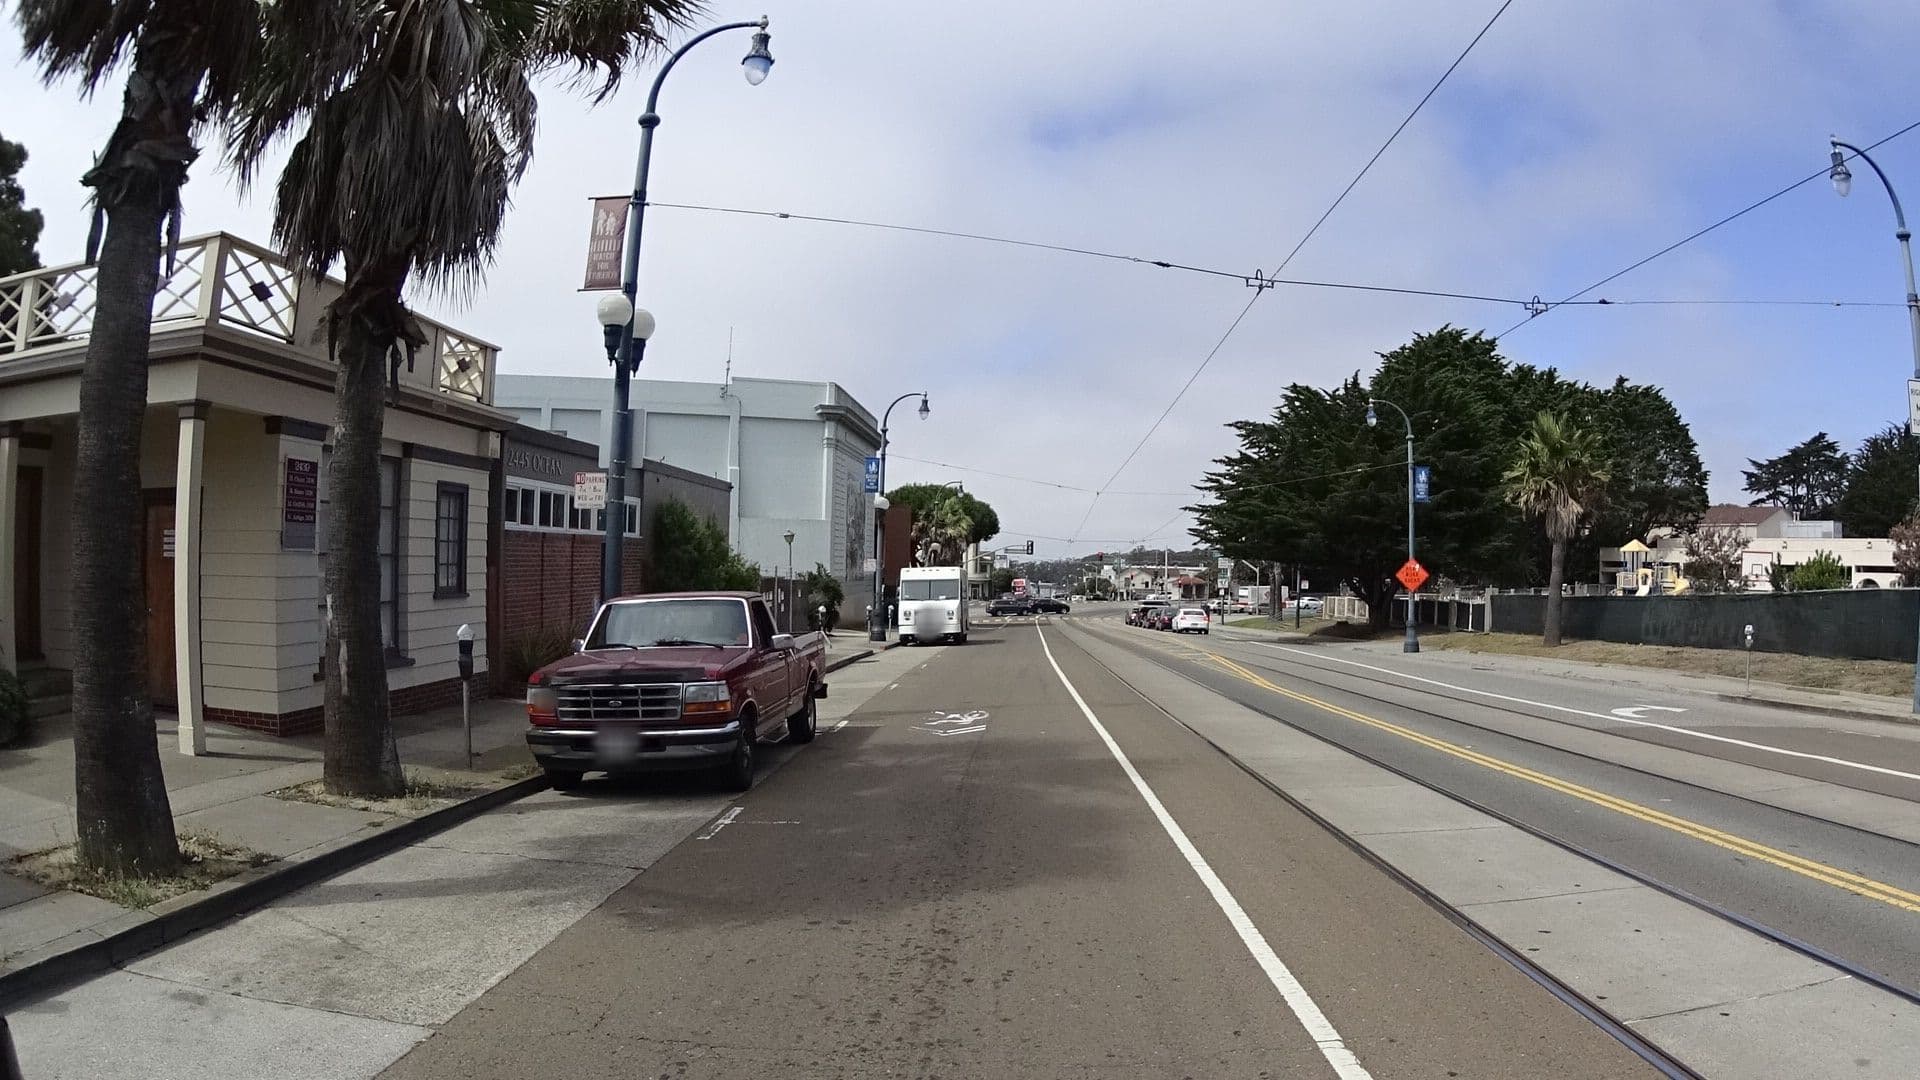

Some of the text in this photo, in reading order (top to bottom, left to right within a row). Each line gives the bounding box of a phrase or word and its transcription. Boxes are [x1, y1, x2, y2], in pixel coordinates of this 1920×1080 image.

[506, 448, 563, 476] 2445 OCEAN
[576, 473, 585, 484] NO
